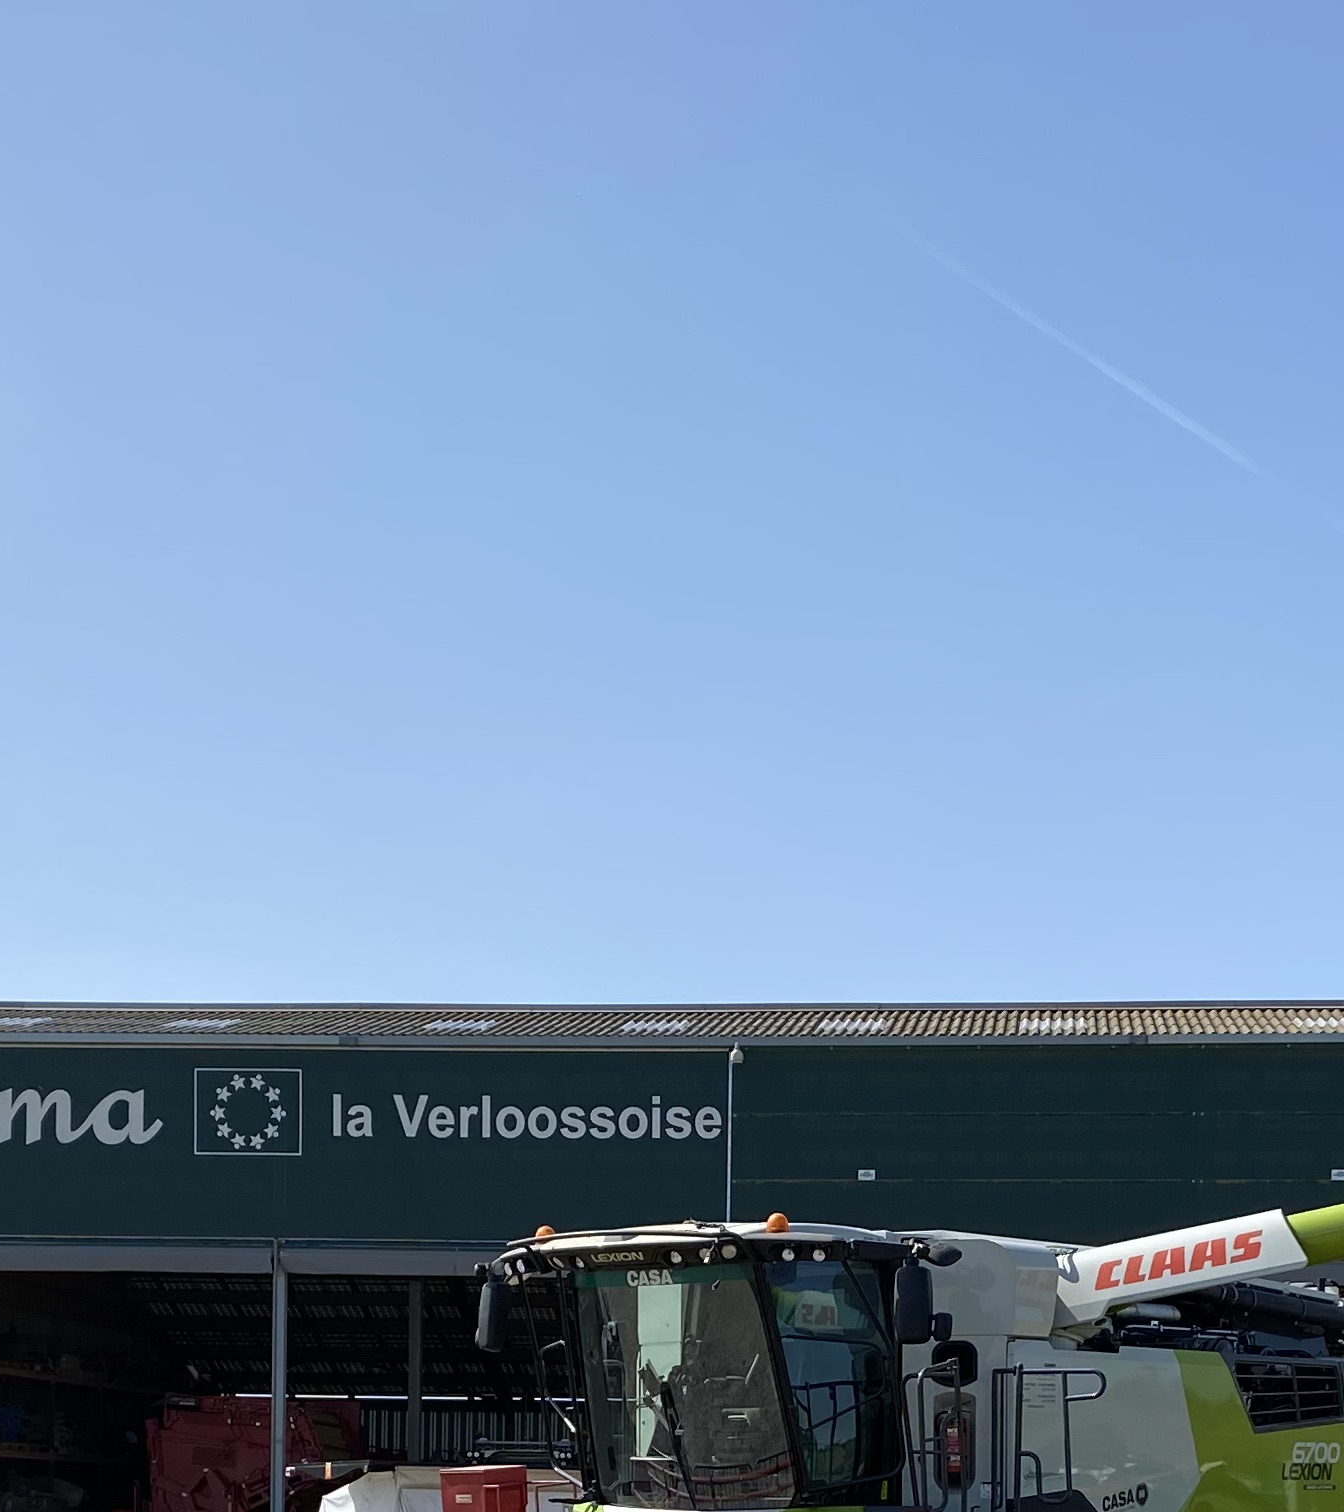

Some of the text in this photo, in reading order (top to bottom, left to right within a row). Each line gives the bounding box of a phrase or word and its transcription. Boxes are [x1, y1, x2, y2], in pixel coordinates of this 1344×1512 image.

[332, 1093, 723, 1139] la Verloossoise
[590, 1251, 644, 1263] LEXION
[1094, 1229, 1263, 1291] CLAAS
[626, 1269, 674, 1287] CASA
[1292, 1441, 1341, 1464] 6700
[1282, 1462, 1333, 1481] LEXION
[1102, 1488, 1135, 1512] CASA
